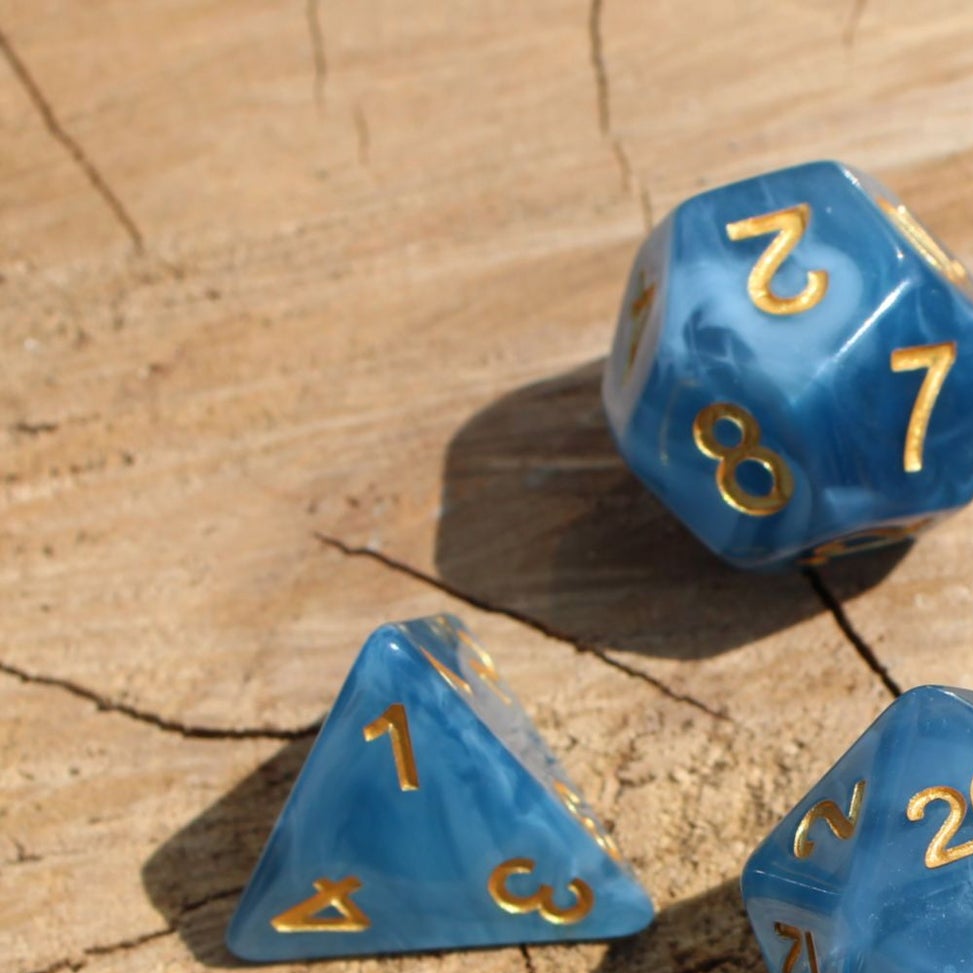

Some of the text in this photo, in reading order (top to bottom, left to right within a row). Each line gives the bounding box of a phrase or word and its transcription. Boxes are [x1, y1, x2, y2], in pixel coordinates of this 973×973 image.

[725, 202, 829, 316] 2
[890, 341, 957, 472] 7
[692, 402, 795, 517] 8
[362, 703, 419, 791] 1
[793, 779, 867, 859] 2
[270, 875, 371, 933] 4
[487, 857, 595, 925] 3
